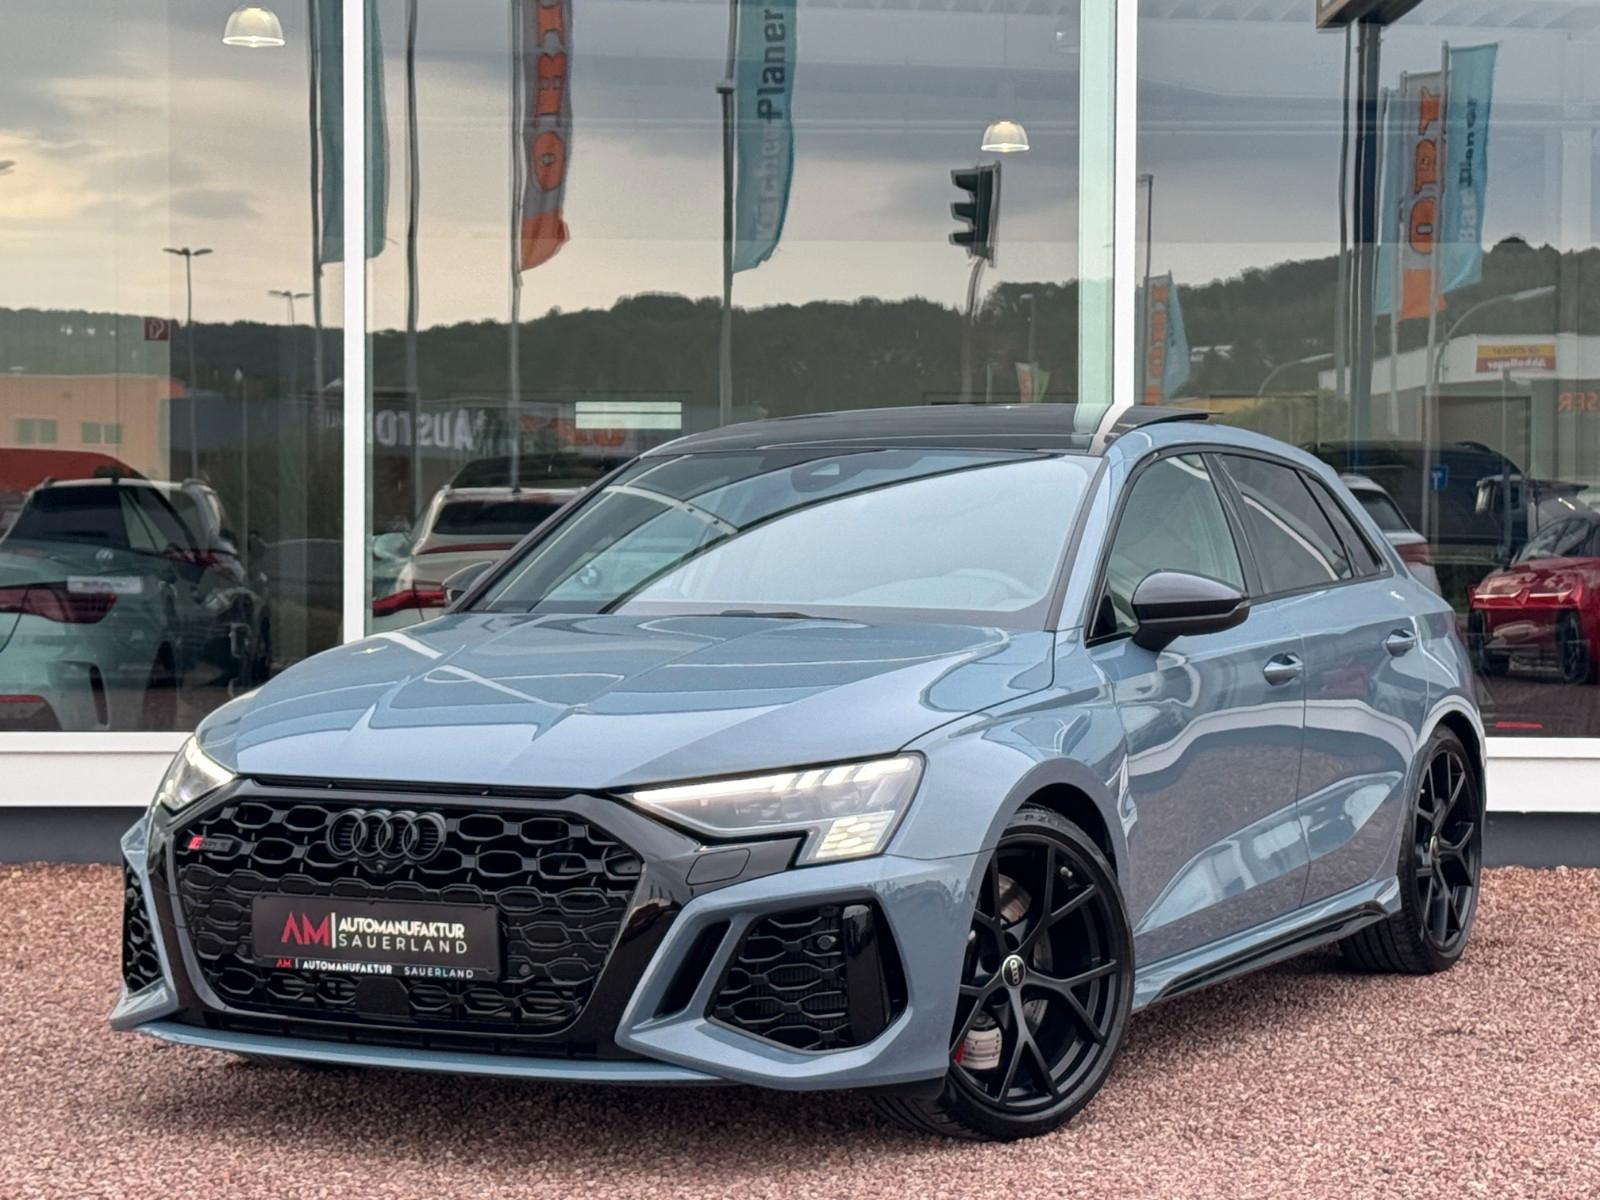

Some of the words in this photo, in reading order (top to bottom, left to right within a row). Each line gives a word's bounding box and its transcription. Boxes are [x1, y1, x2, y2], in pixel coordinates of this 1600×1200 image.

[280, 911, 330, 947] AM
[338, 917, 465, 940] AUTOMANUFAKTUR
[338, 934, 468, 955] SAUERLAND
[302, 960, 393, 975] AUTOMANUFAKTUR
[403, 966, 474, 979] SAUERLAND
